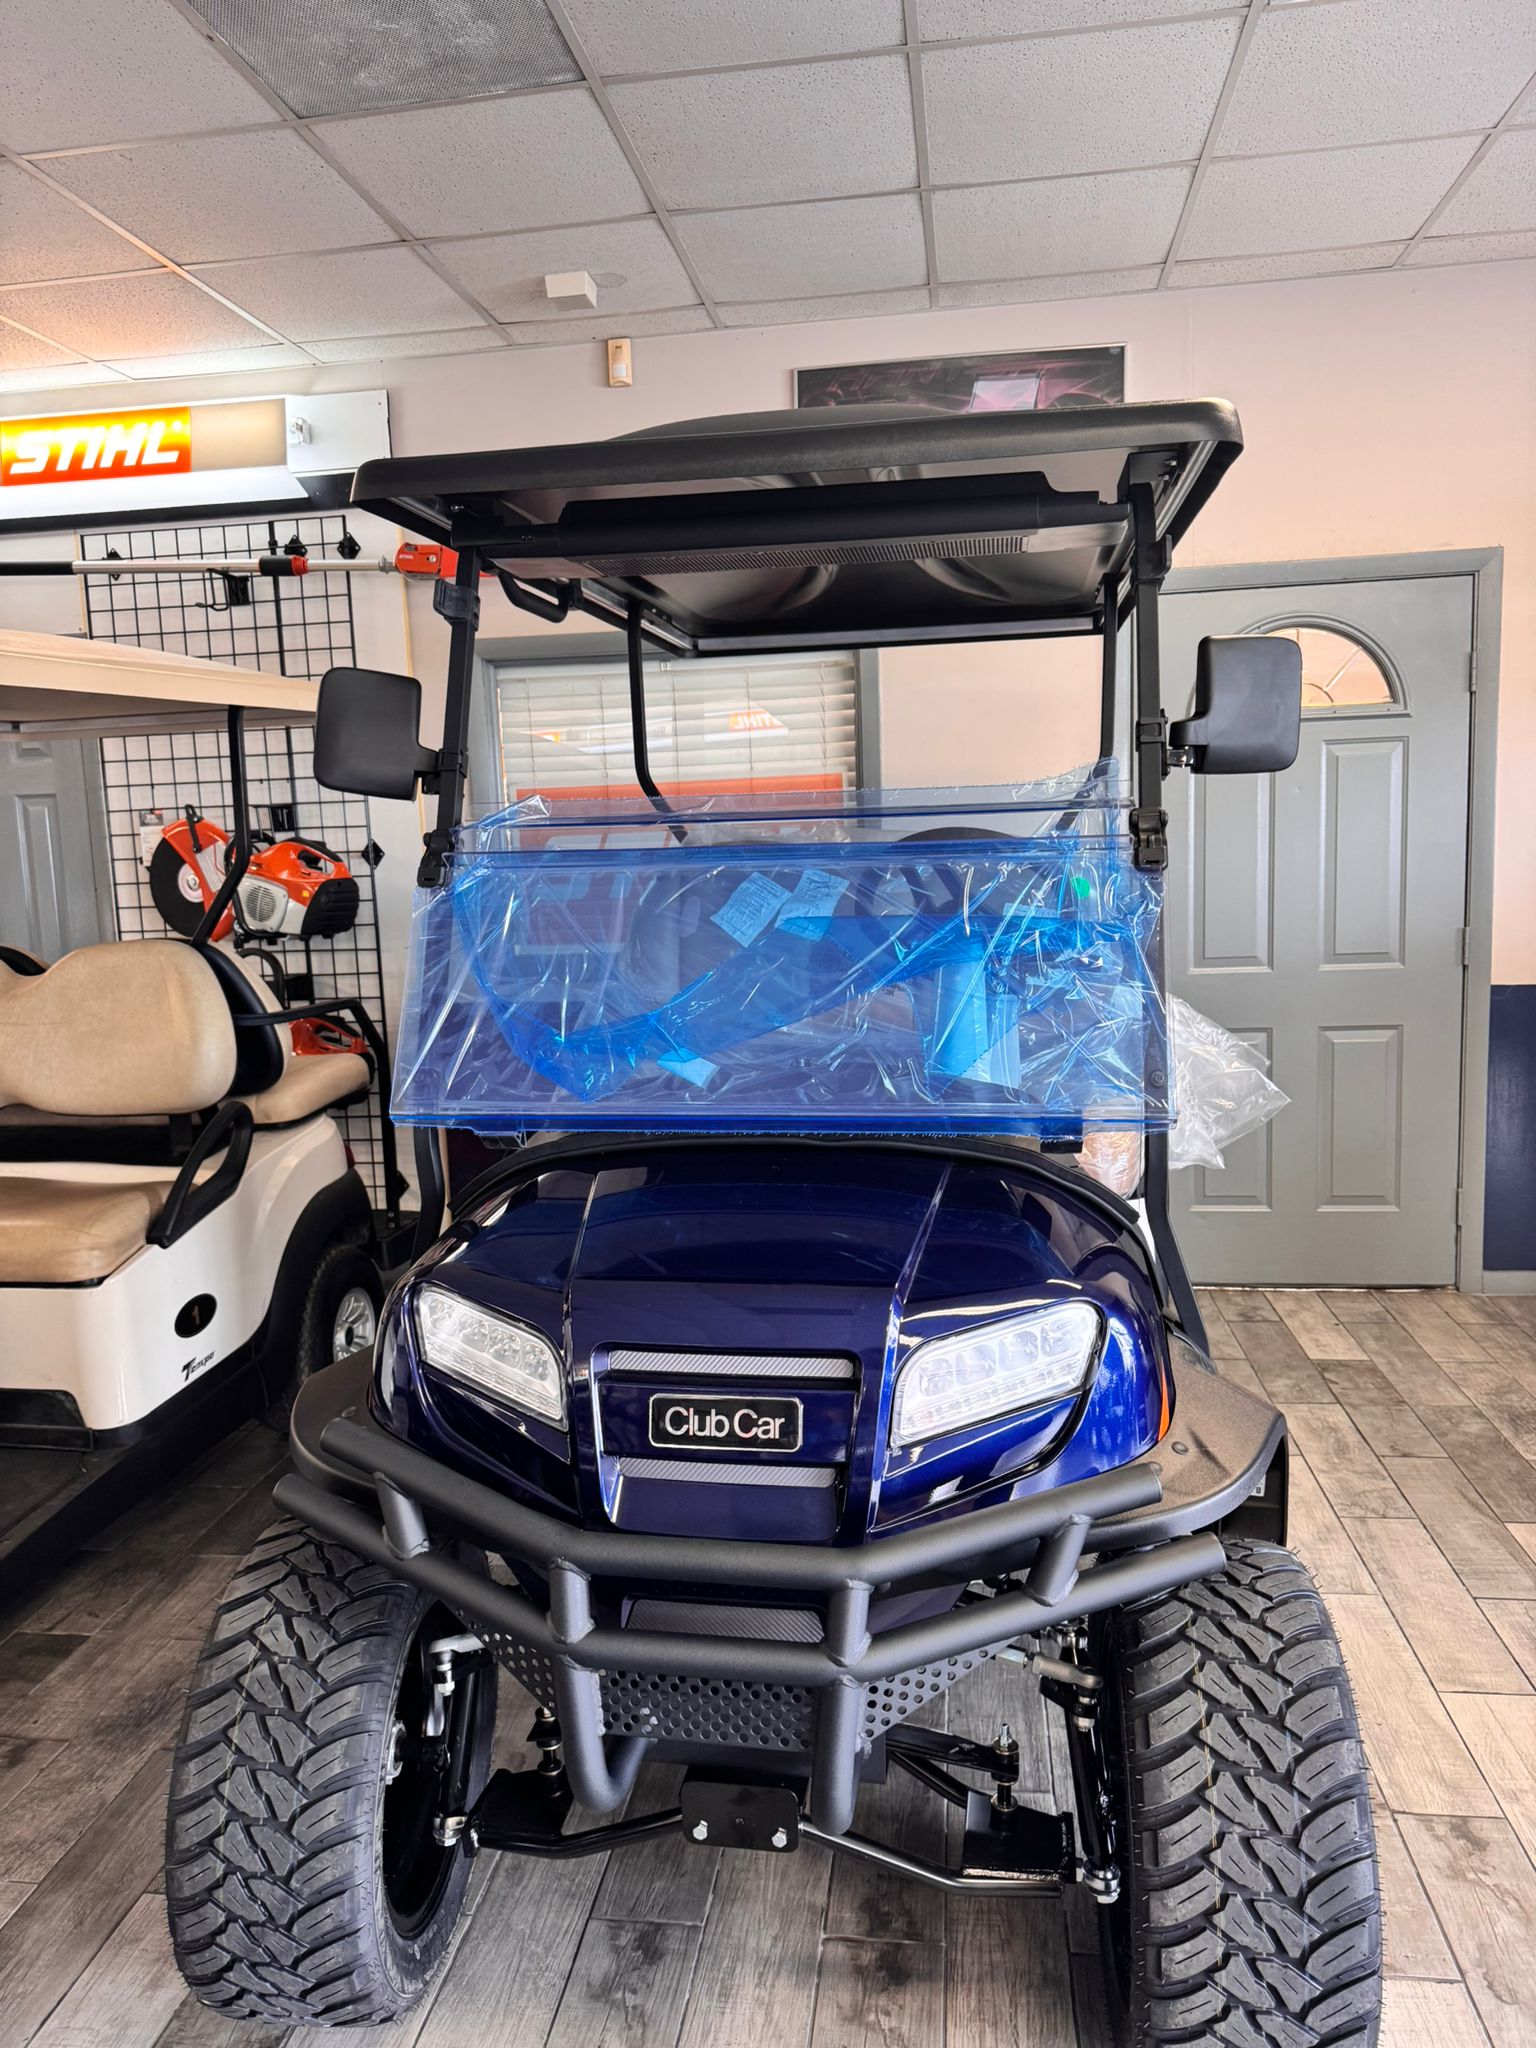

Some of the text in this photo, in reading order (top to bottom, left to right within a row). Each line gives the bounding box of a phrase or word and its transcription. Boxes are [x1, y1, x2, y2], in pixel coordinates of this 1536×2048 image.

[10, 421, 181, 475] STIHL
[182, 1351, 215, 1382] Tempo
[664, 1406, 785, 1440] Club Car
